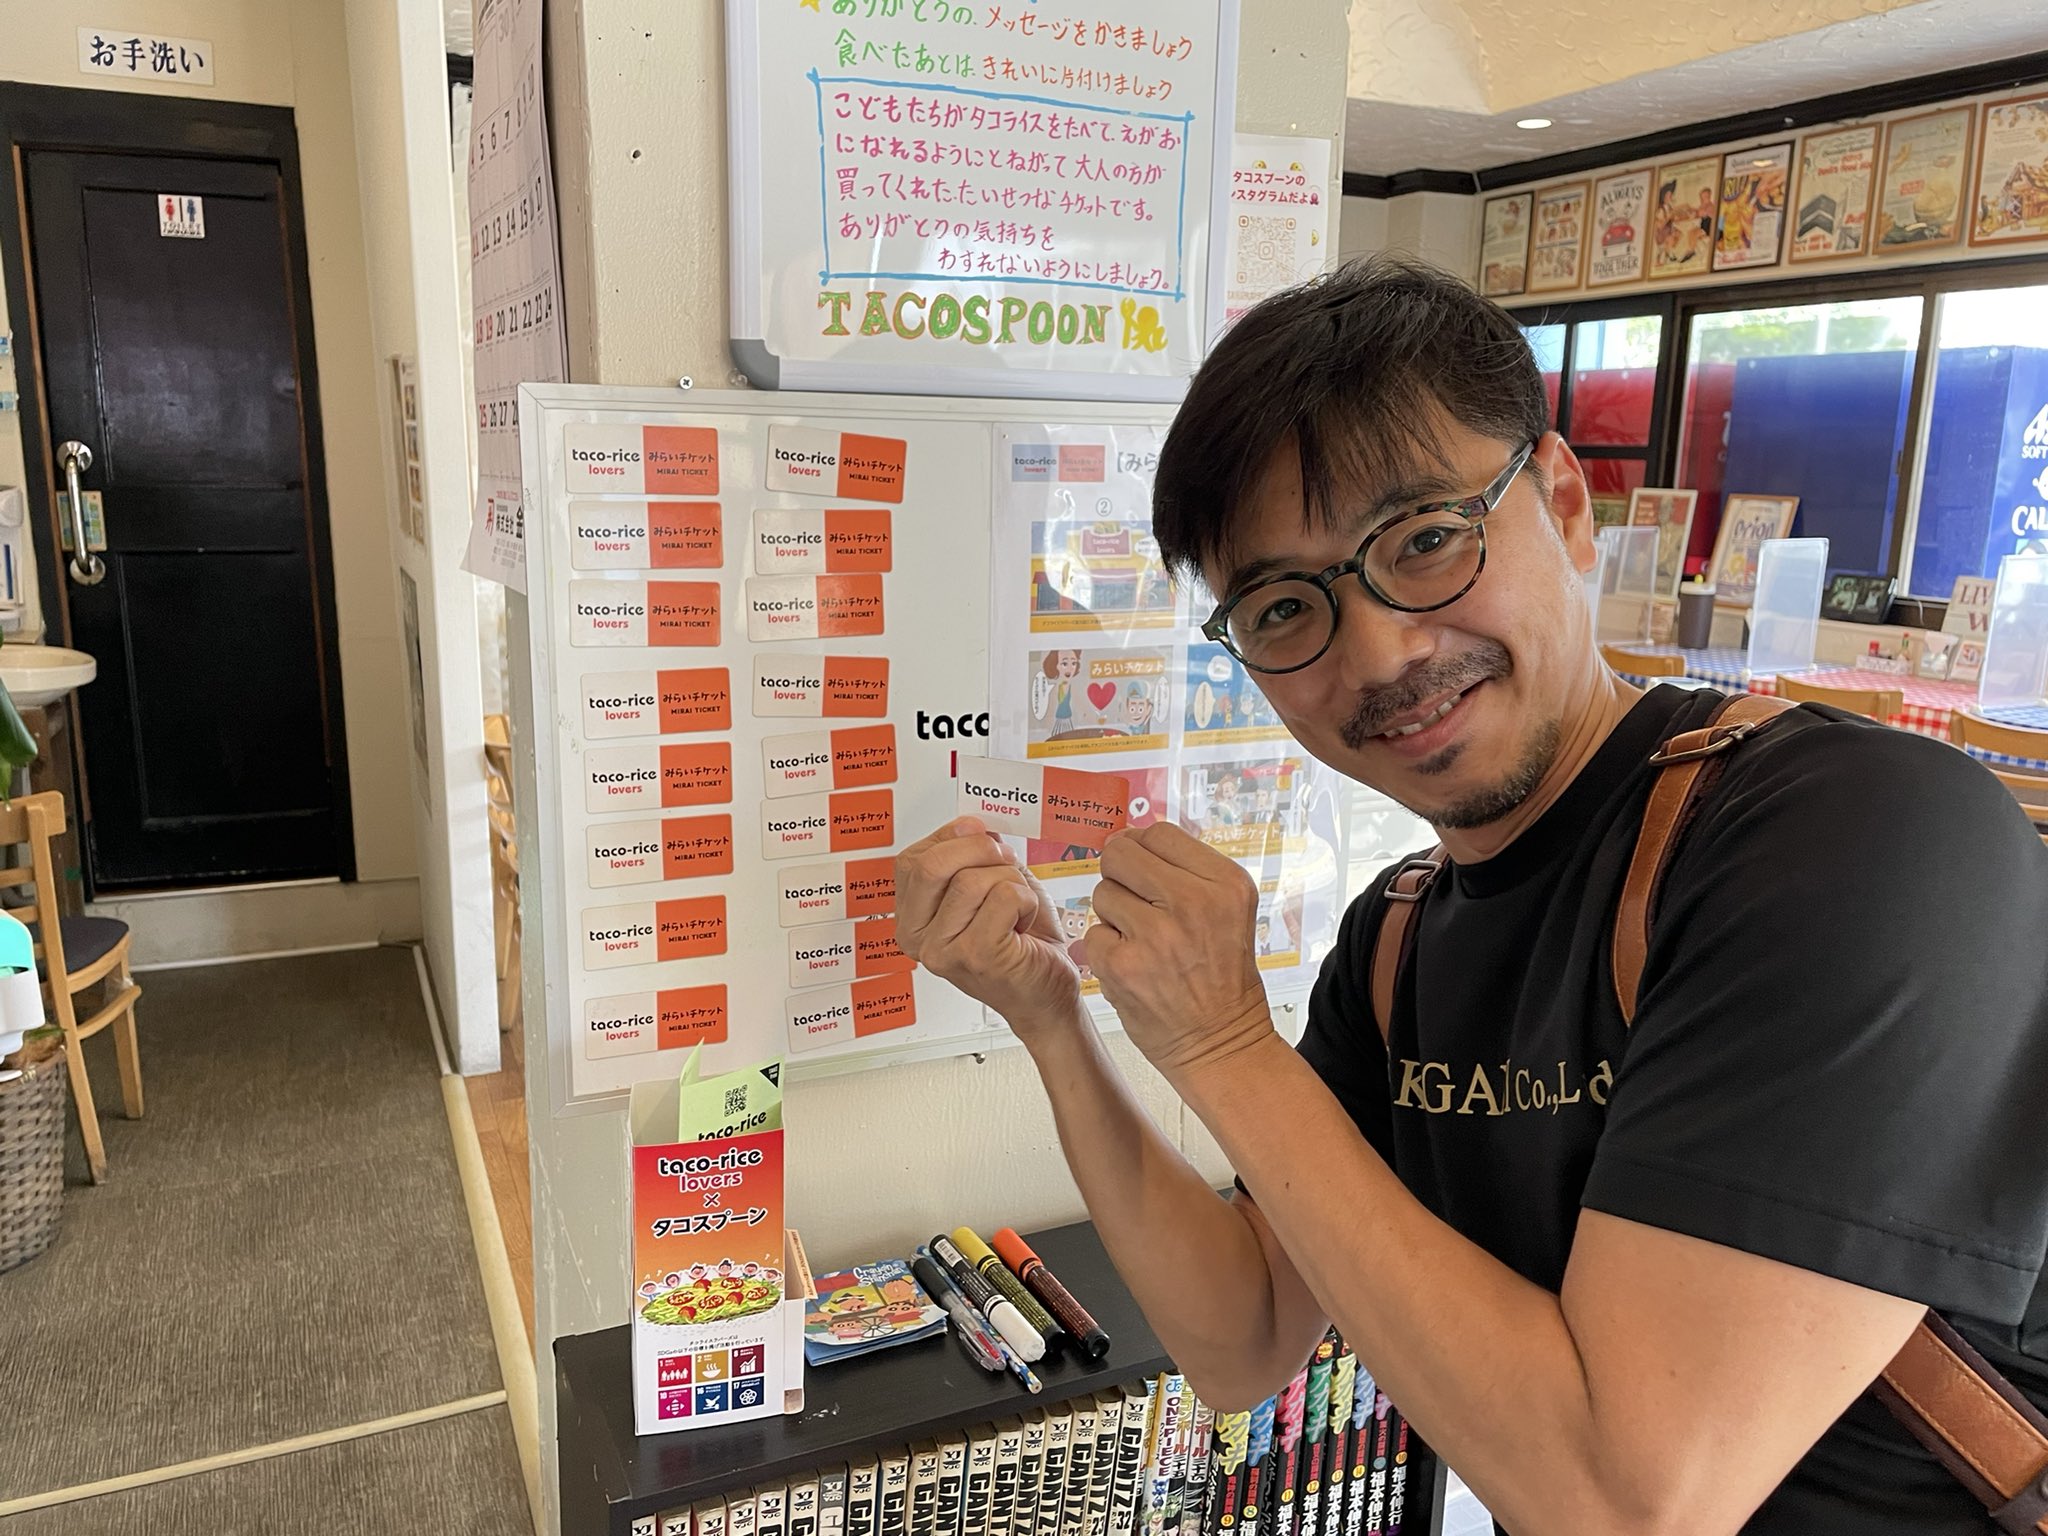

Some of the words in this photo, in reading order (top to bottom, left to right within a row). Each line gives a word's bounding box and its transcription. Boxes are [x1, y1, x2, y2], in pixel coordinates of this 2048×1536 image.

[89, 35, 205, 76] お手洗い
[505, 110, 510, 140] 7
[1233, 171, 1306, 186] タコスプーンの
[482, 224, 489, 252] 12
[493, 216, 501, 246] 13
[506, 207, 516, 238] 14
[497, 310, 505, 337] 20
[509, 304, 518, 333] 21
[522, 300, 532, 328] 22
[535, 293, 542, 324] 23
[818, 291, 1112, 345] TACOSPOON
[500, 401, 507, 426] 27
[572, 448, 640, 462] taco-rice
[649, 451, 715, 463] みらいチケット
[775, 448, 836, 466] taco-rice
[1116, 451, 1158, 473] 【みら
[588, 464, 625, 475] lovers
[788, 464, 821, 477] lovers
[843, 457, 902, 472] みらいチケット
[849, 473, 871, 481] MIRAI
[873, 475, 895, 483] TICKET
[578, 526, 645, 538] taco-rice
[653, 526, 719, 537] みらいチケット
[761, 532, 822, 545] taco-rice
[829, 532, 888, 543] みらいチケット
[595, 541, 630, 551] lovers
[776, 547, 808, 557] lovers
[753, 599, 814, 612] taco-rice
[821, 596, 880, 608] みらいチケット
[578, 603, 644, 616] taco-rice
[652, 604, 717, 616] みらいチケット
[593, 618, 629, 629] lovers
[768, 613, 800, 623] lovers
[1090, 660, 1164, 676] みらいチケット
[761, 677, 820, 688] taco-rice
[828, 678, 886, 689] みらいチケット
[589, 694, 654, 708] taco-rice
[663, 691, 727, 703] みらいチケット
[774, 691, 806, 700] lovers
[605, 709, 640, 720] lovers
[917, 710, 989, 740] taco
[836, 746, 893, 760] みらいチケット
[770, 752, 829, 769] taco-rice
[592, 769, 657, 783] taco-rice
[665, 765, 728, 778] みらいチケット
[785, 768, 816, 779] lovers
[608, 784, 642, 794] lovers
[965, 782, 1038, 805] taco-rice
[981, 799, 1021, 816] lovers
[1047, 794, 1124, 816] みらいチケット
[768, 817, 826, 832] taco-rice
[833, 811, 890, 824] みらいチケット
[1055, 813, 1080, 824] MIRAI
[1083, 817, 1114, 830] TICKET
[667, 837, 729, 850] みらいチケット
[782, 831, 813, 842] lovers
[595, 842, 659, 858] taco-rice
[610, 858, 644, 869] lovers
[785, 883, 842, 899] taco-rice
[849, 879, 896, 891] みらいチケ
[799, 898, 829, 909] lovers
[661, 918, 723, 932] みらいチケット
[589, 924, 653, 941] taco-rice
[605, 940, 638, 952] lovers
[796, 943, 852, 960] taco-rice
[859, 938, 897, 951] みらいチ
[809, 958, 839, 969] lovers
[856, 992, 912, 1011] みらいチケット
[661, 1007, 723, 1021] みらいチケット
[793, 1006, 850, 1026] taco-rice
[863, 1012, 884, 1020] MIRAI
[886, 1005, 907, 1016] TICKET
[591, 1014, 653, 1031] taco-rice
[808, 1020, 838, 1034] lovers
[606, 1029, 639, 1041] lovers
[1515, 1060, 1615, 1116] Co.,Ld
[659, 1148, 762, 1175] taco-rice
[681, 1173, 741, 1191] lovers
[653, 1208, 766, 1237] タコスプーン
[853, 1264, 893, 1280] Crayon
[1158, 1428, 1176, 1477] PIECE
[1087, 1433, 1116, 1515] GANTZ
[1113, 1427, 1142, 1507] GANTZ
[1063, 1443, 1092, 1525] GANTZ
[1366, 1469, 1387, 1532] 福本伸行
[1388, 1465, 1408, 1526] 福本伸行
[1116, 1511, 1131, 1529] 32
